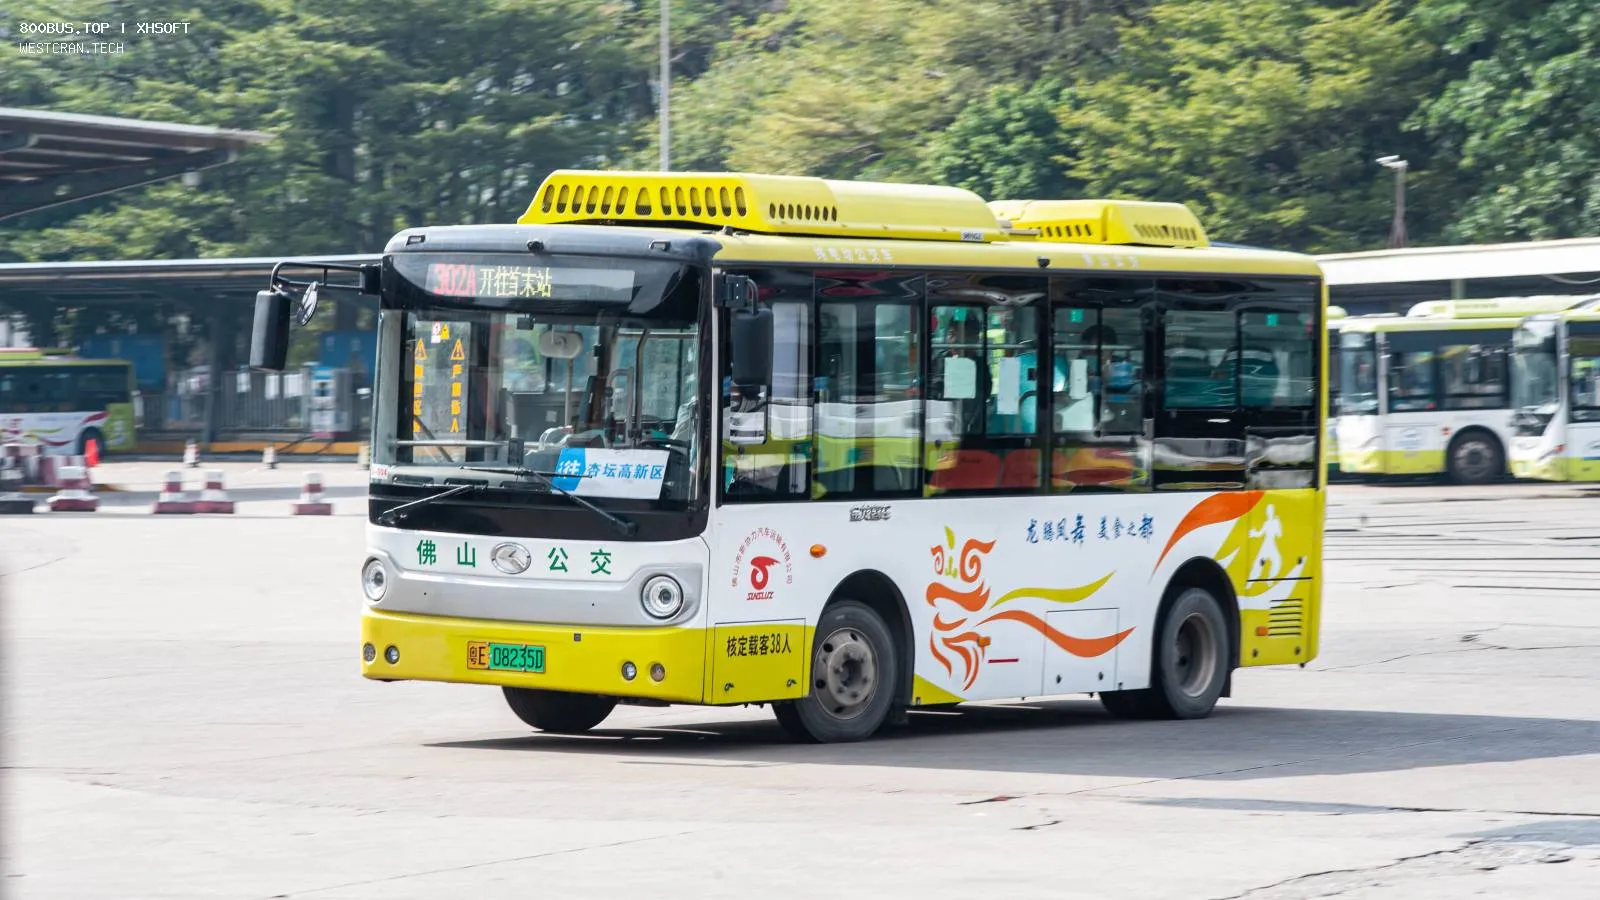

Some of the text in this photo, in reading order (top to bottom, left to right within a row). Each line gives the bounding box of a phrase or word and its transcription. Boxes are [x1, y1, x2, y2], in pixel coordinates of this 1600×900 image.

[587, 463, 664, 480] 杏坛高新区
[416, 539, 612, 575] 佛山 公交
[727, 632, 792, 658] 核定载客38人
